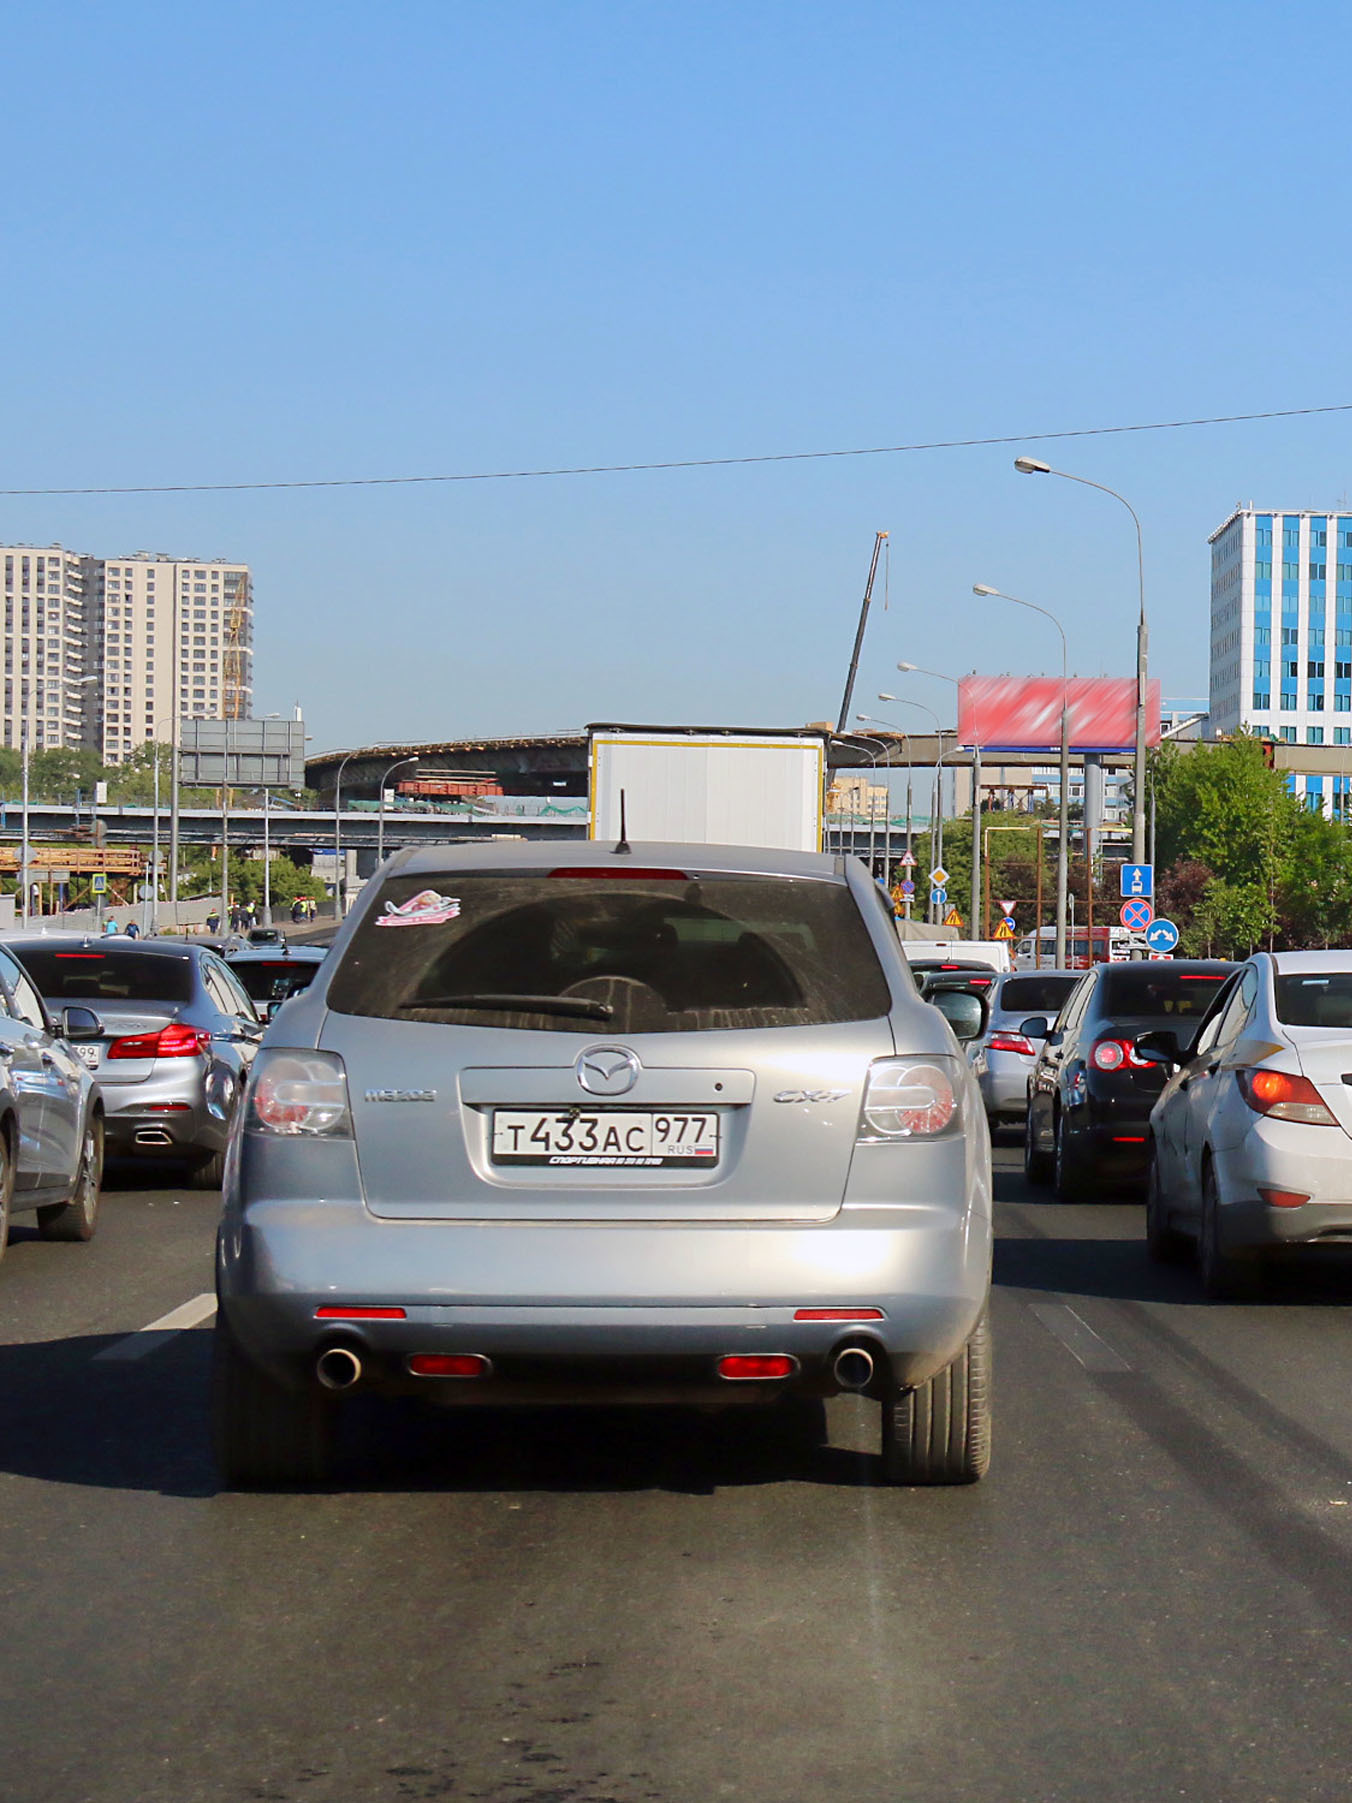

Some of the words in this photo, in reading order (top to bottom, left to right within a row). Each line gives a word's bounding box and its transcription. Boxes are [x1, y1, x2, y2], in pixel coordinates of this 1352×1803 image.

[507, 1117, 645, 1152] Т433АС
[654, 1117, 708, 1143] 977
[667, 1145, 694, 1155] RUS
